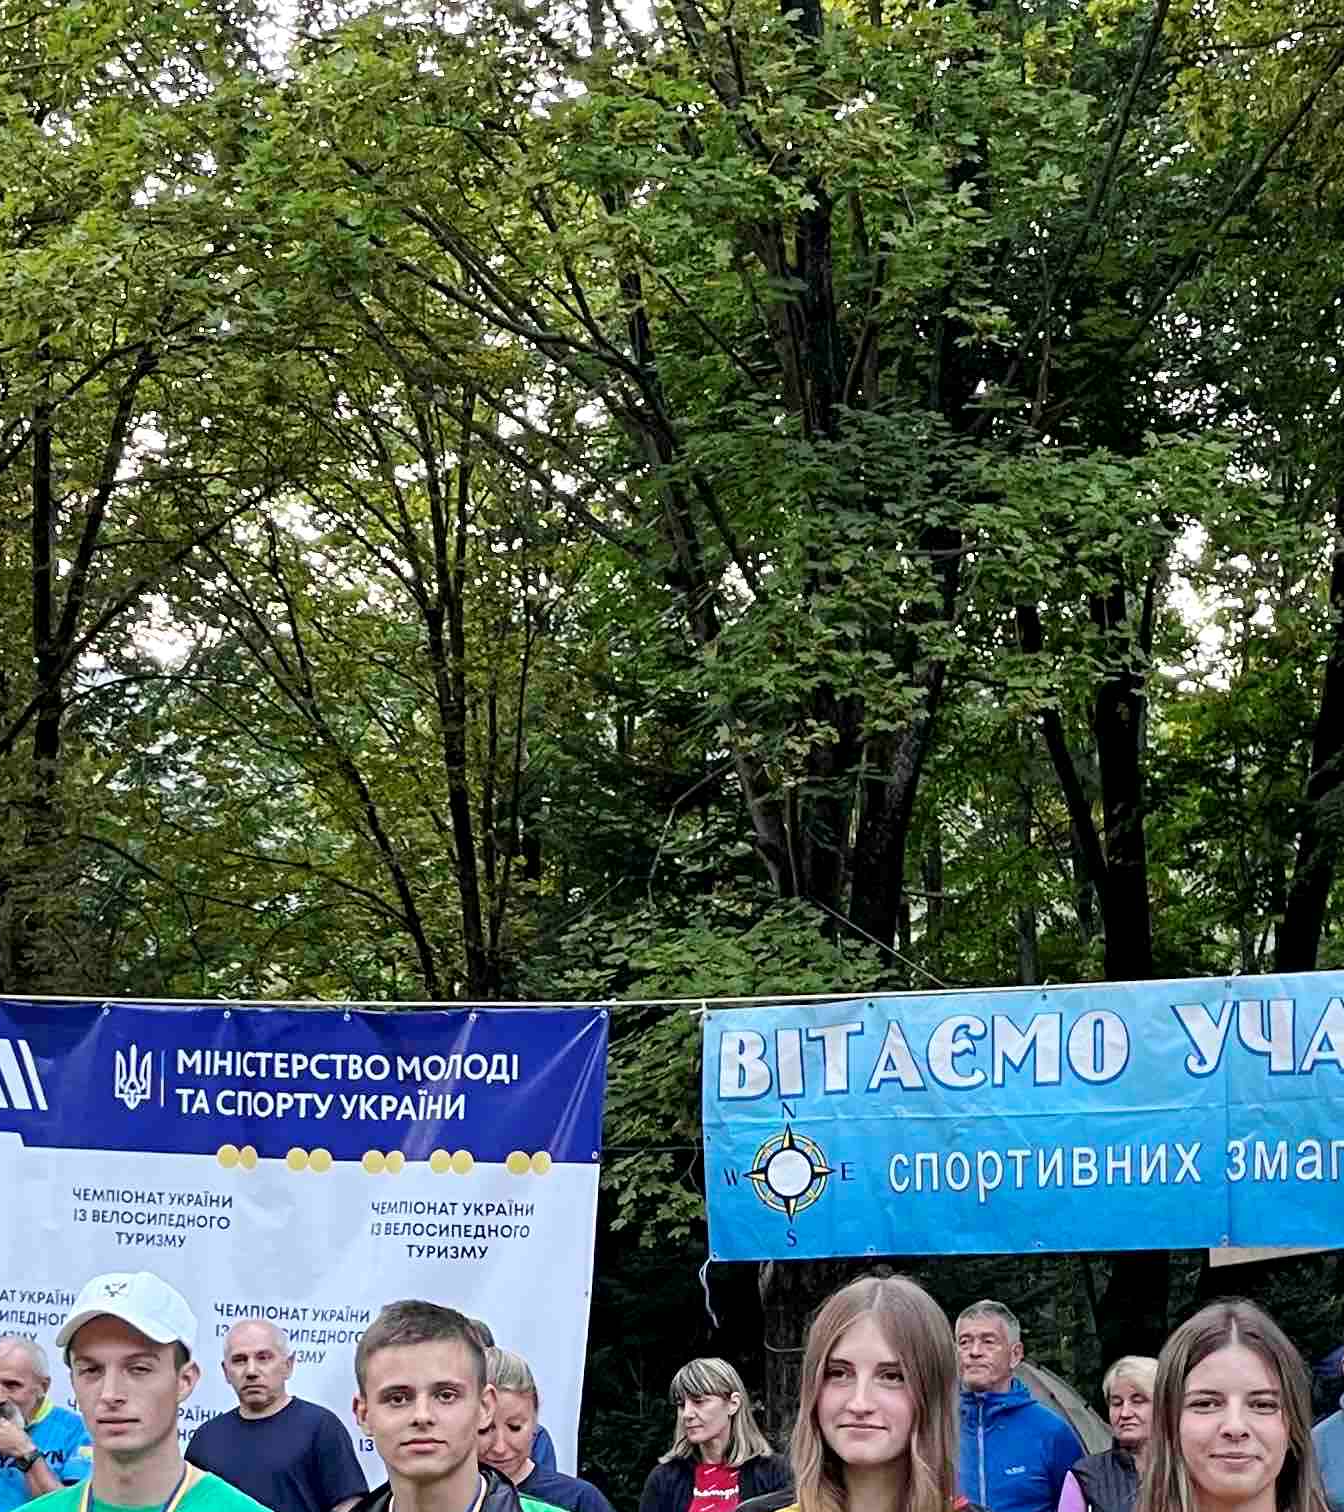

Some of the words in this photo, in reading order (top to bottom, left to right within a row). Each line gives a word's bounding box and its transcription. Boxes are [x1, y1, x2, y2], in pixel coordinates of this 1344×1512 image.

[718, 1009, 1130, 1101] ВІТАЄМО
[176, 1049, 390, 1081] МІНІСТЕРСТВО
[397, 1054, 518, 1084] МОЛОДІ
[176, 1090, 210, 1115] ТА
[215, 1090, 330, 1120] СПОРТУ
[341, 1091, 465, 1122] УКРАЇНИ
[782, 1101, 797, 1119] N
[724, 1167, 739, 1186] W
[841, 1161, 856, 1181] E
[889, 1140, 1202, 1204] спортивних
[72, 1186, 164, 1206] ЧЕМПІОНАТ
[168, 1190, 233, 1209] УКРАЇНИ
[371, 1200, 458, 1217] ЧЕМПІОНАТ
[462, 1198, 535, 1217] УКРАЇНИ
[73, 1210, 88, 1223] ІЗ
[92, 1209, 231, 1230] ВЕЛОСИПЕДНОГО
[116, 1232, 186, 1248] ТУРИЗМУ
[370, 1223, 383, 1236] ІЗ
[384, 1222, 530, 1241] ВЕЛОСИПЕДНОГО
[786, 1228, 798, 1248] S
[406, 1244, 489, 1260] ТУРИЗМУ
[19, 1289, 76, 1306] УКРАЇН
[214, 1303, 307, 1322] ЧЕМПІОНАТ
[312, 1308, 370, 1323] УКРАЇНИ
[288, 1330, 364, 1343] СИПЕДНОГО
